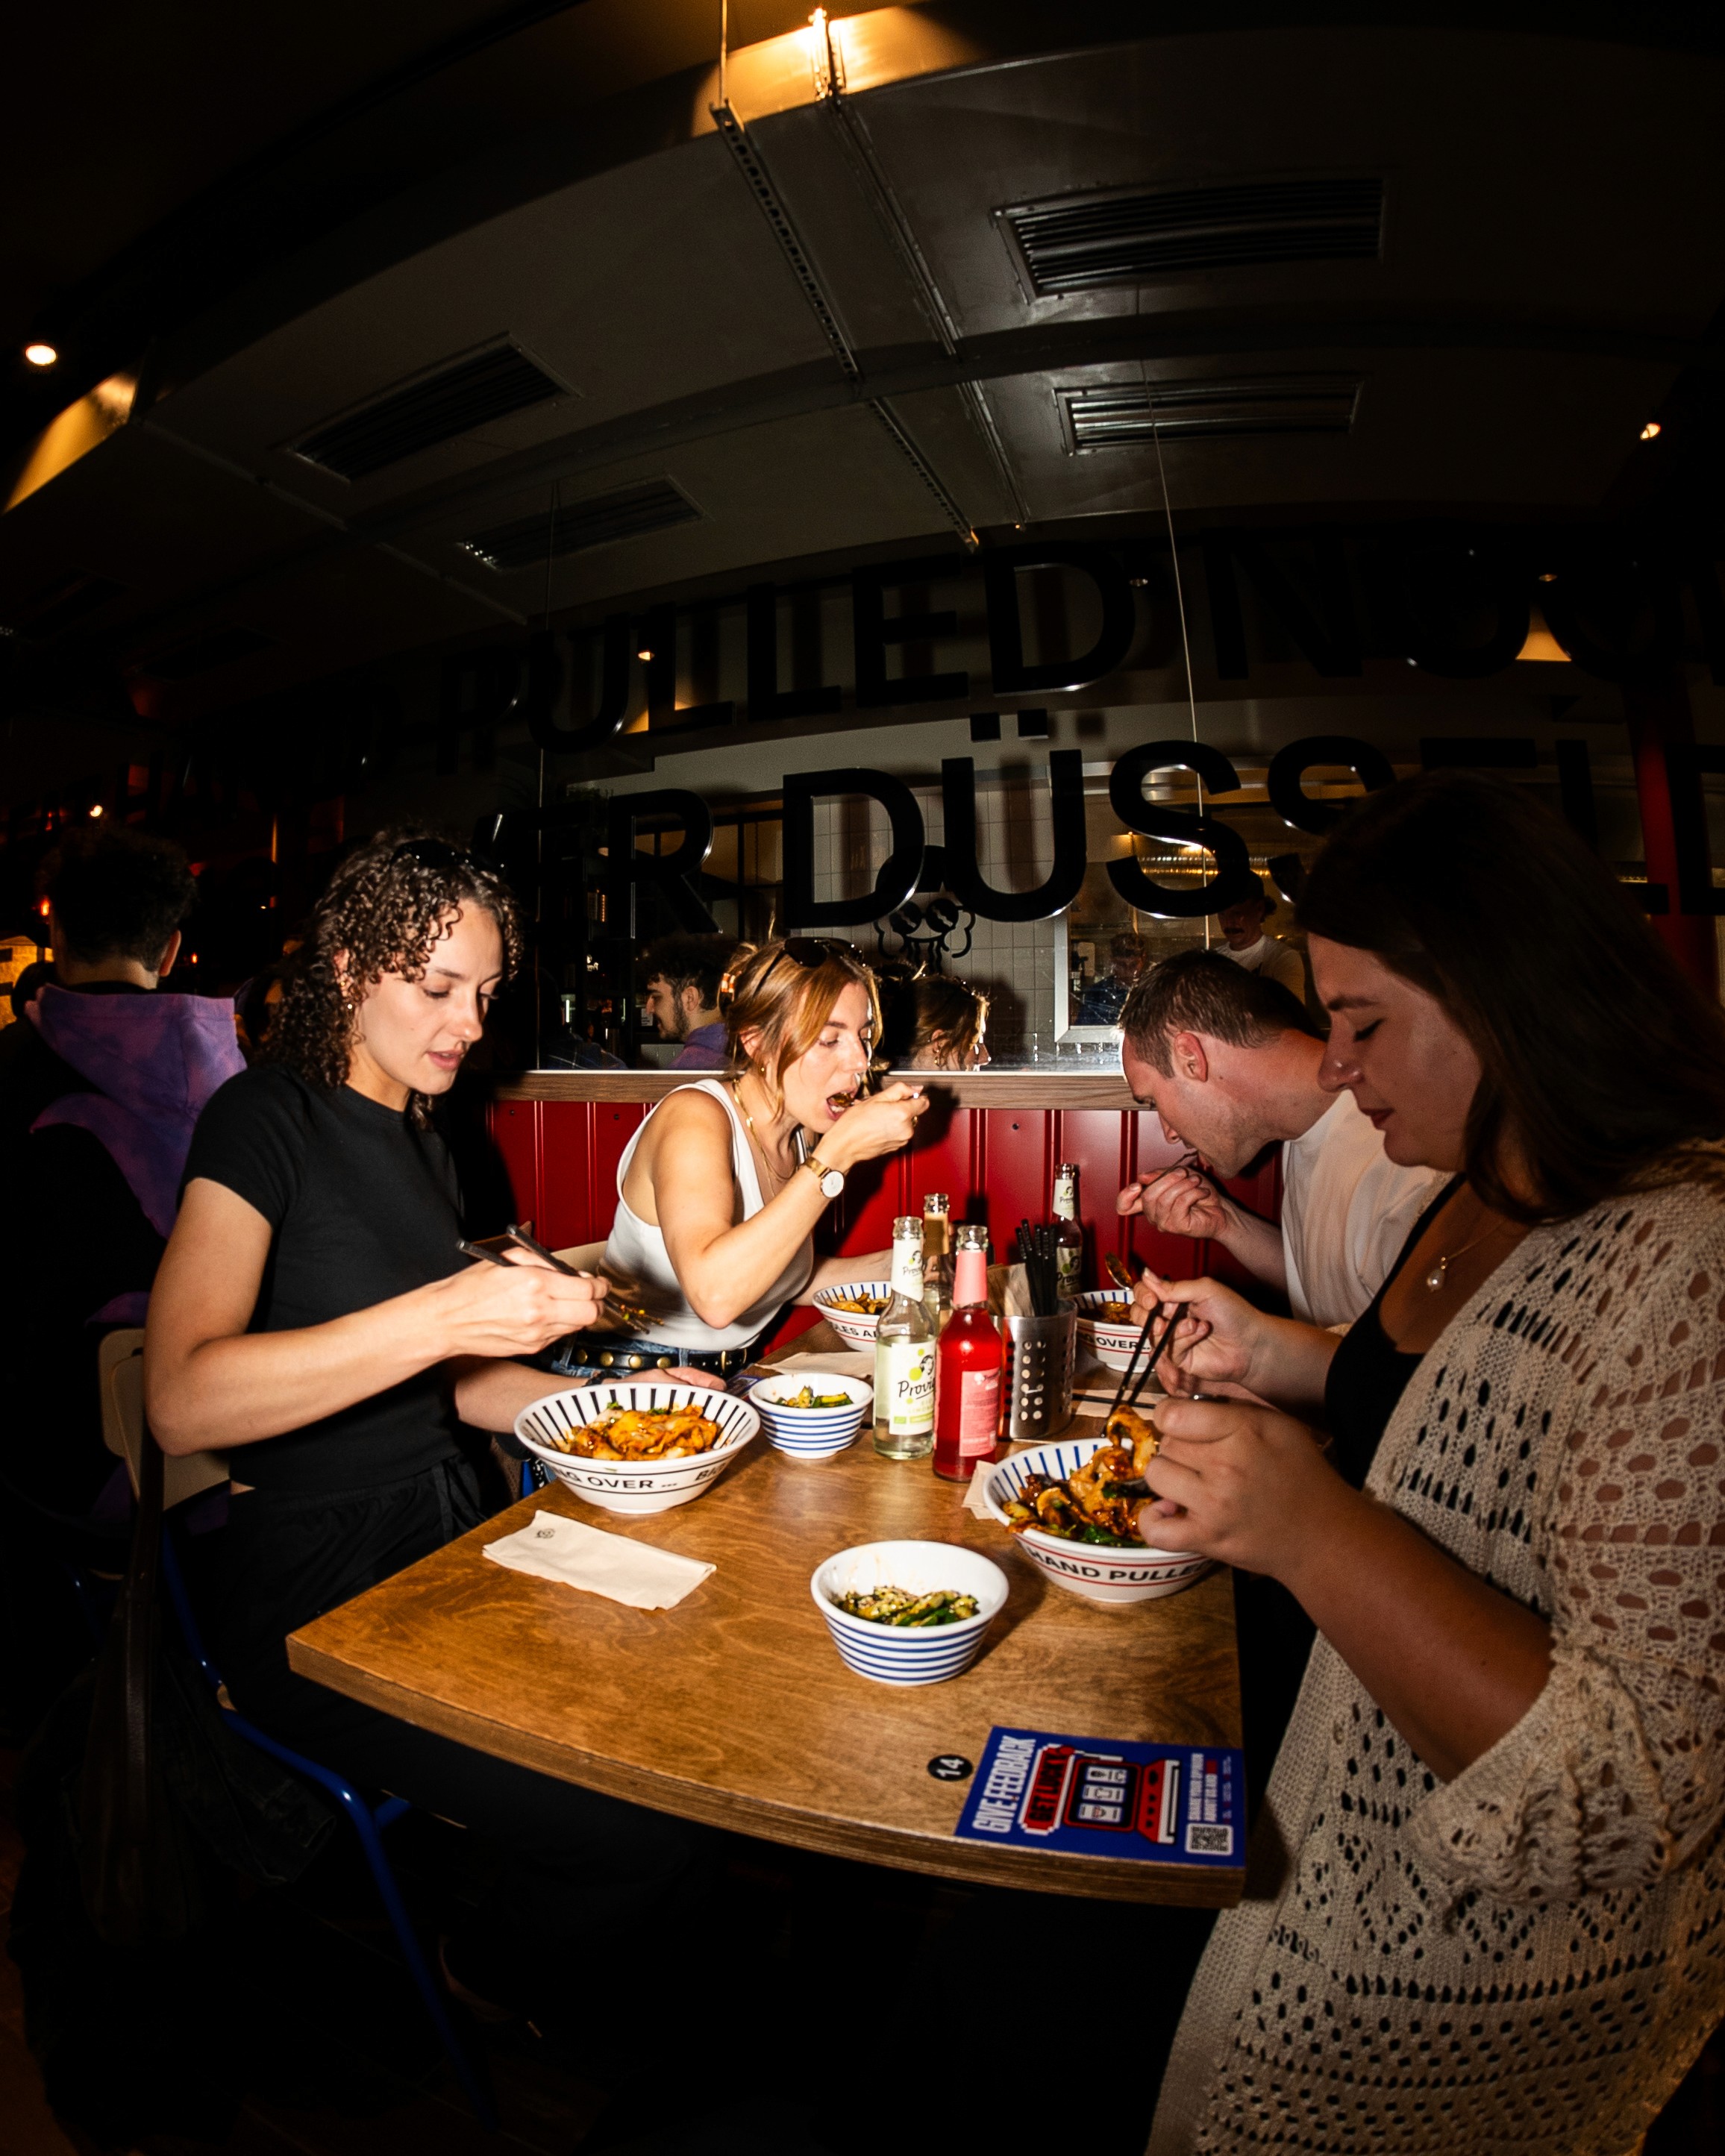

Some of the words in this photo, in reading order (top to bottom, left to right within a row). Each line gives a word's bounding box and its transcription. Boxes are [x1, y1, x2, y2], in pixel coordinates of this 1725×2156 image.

[437, 542, 1135, 776] PULLED
[1200, 516, 1725, 686] NOO
[783, 709, 1725, 929] DÜSSL
[898, 1377, 936, 1398] Provi
[587, 1476, 654, 1489] OVER
[1027, 1547, 1100, 1577] HAND
[936, 1758, 965, 1778] 14
[983, 1734, 1037, 1802] FEEDBACK
[971, 1797, 1018, 1833] GIVE
[1028, 1796, 1056, 1821] GET
